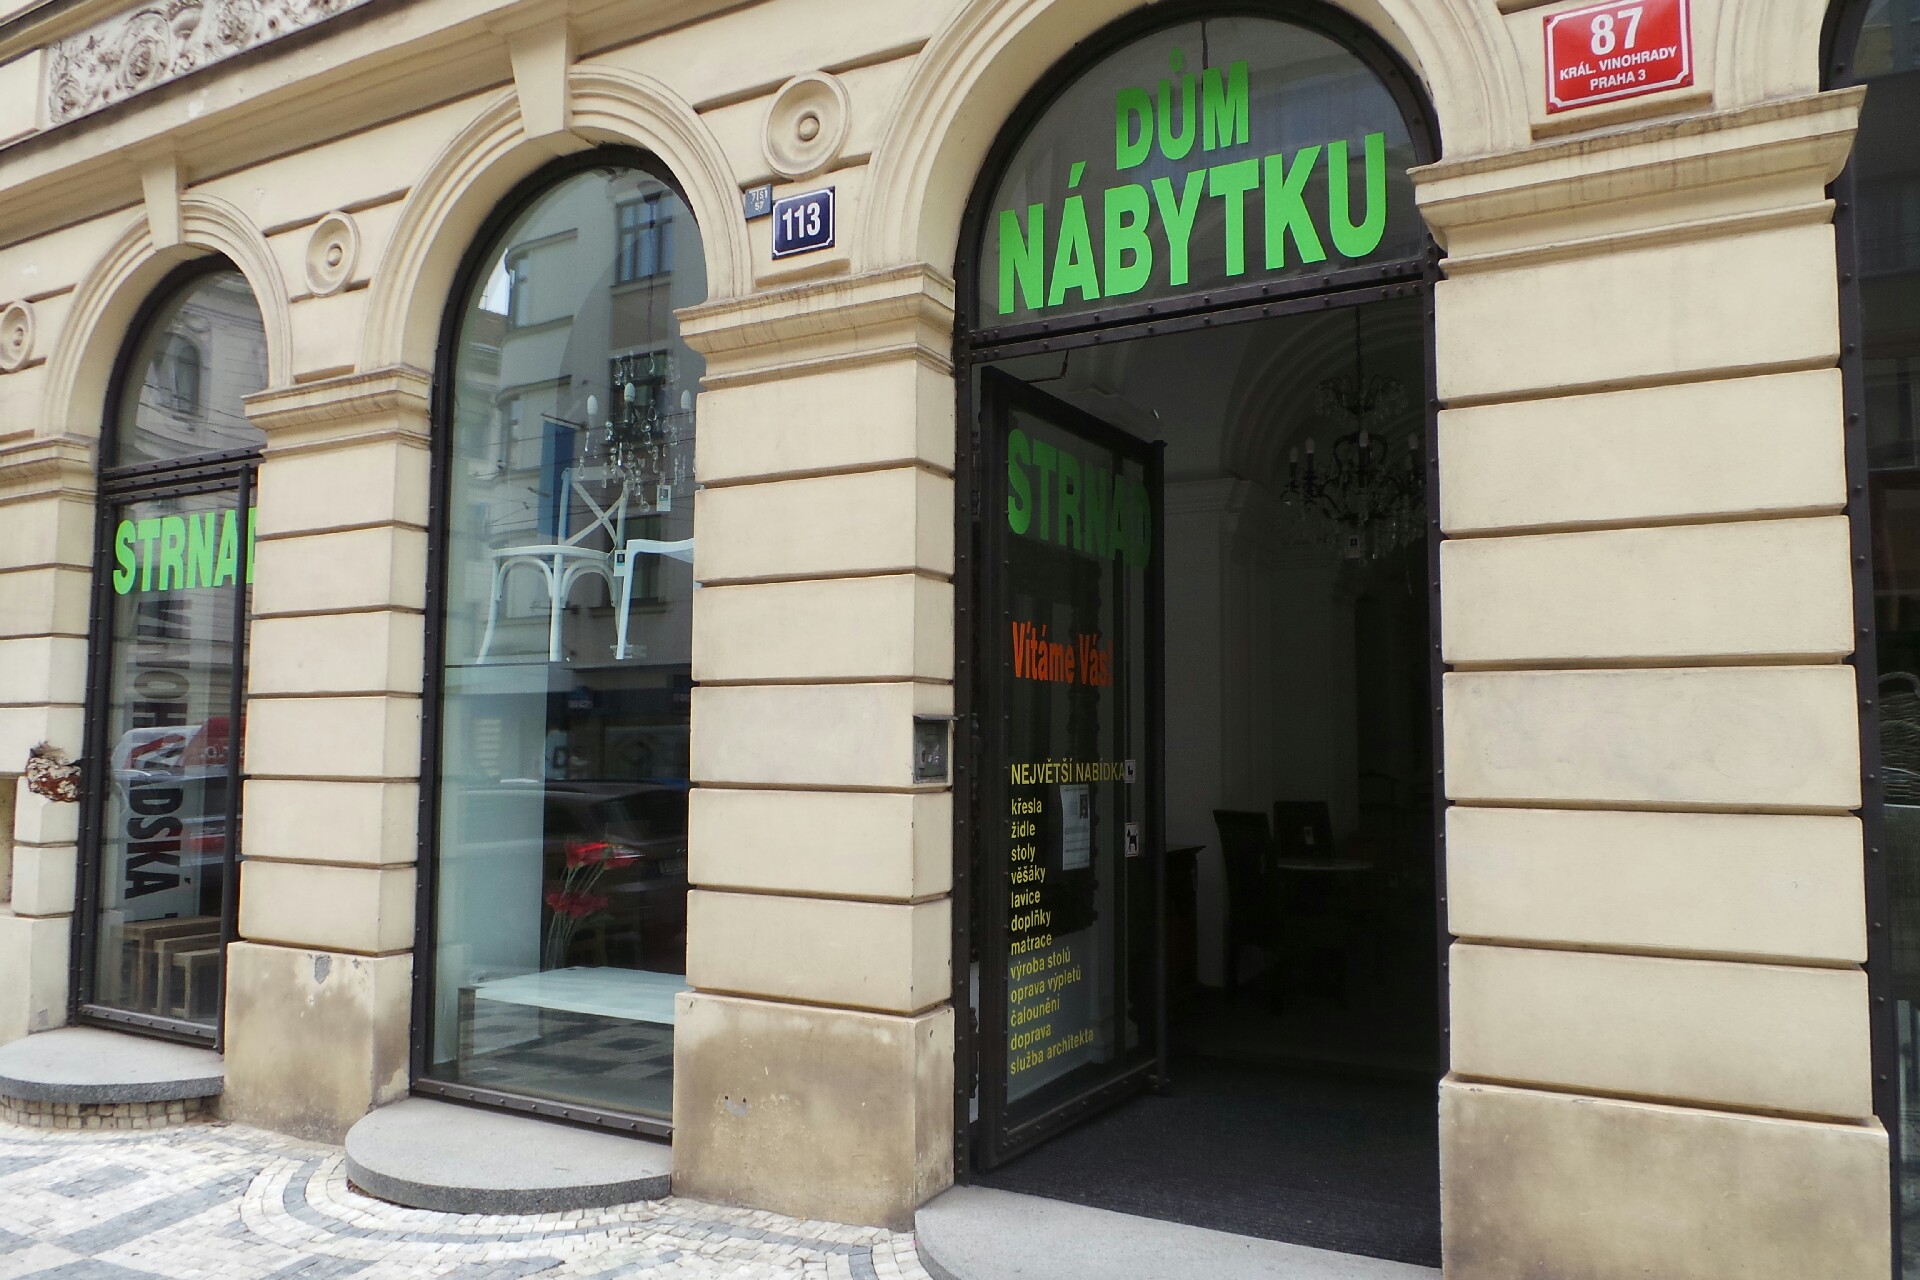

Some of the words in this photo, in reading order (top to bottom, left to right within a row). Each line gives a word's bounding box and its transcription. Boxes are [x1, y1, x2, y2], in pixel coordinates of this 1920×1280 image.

[1591, 6, 1643, 55] 87
[1560, 61, 1596, 80] KRÁL.
[1599, 46, 1677, 71] VINOHRADY
[1590, 73, 1635, 90] PRAHA
[1638, 69, 1646, 81] 3
[1116, 46, 1249, 170] DŮM
[782, 202, 821, 240] 113
[999, 132, 1386, 314] NÁBYTKU
[1007, 428, 1152, 569] STRNAD
[1012, 621, 1075, 684] Vítáme
[1011, 757, 1073, 785] NEJVĚTŠÍ
[1011, 797, 1042, 815] křesla
[1011, 820, 1036, 839] židle
[1011, 843, 1036, 862] stoly
[1011, 865, 1046, 884] věšáky
[1011, 889, 1041, 908] lavice
[1011, 909, 1051, 932] doplňky
[1011, 933, 1052, 955] matrace
[1010, 958, 1045, 982] výroba
[1047, 946, 1071, 969] stolů
[1011, 981, 1045, 1005] oprava
[1047, 965, 1081, 993] výpletů
[1010, 1050, 1044, 1075] služba
[1046, 1028, 1095, 1060] architekta
[1011, 1024, 1052, 1051] doprava
